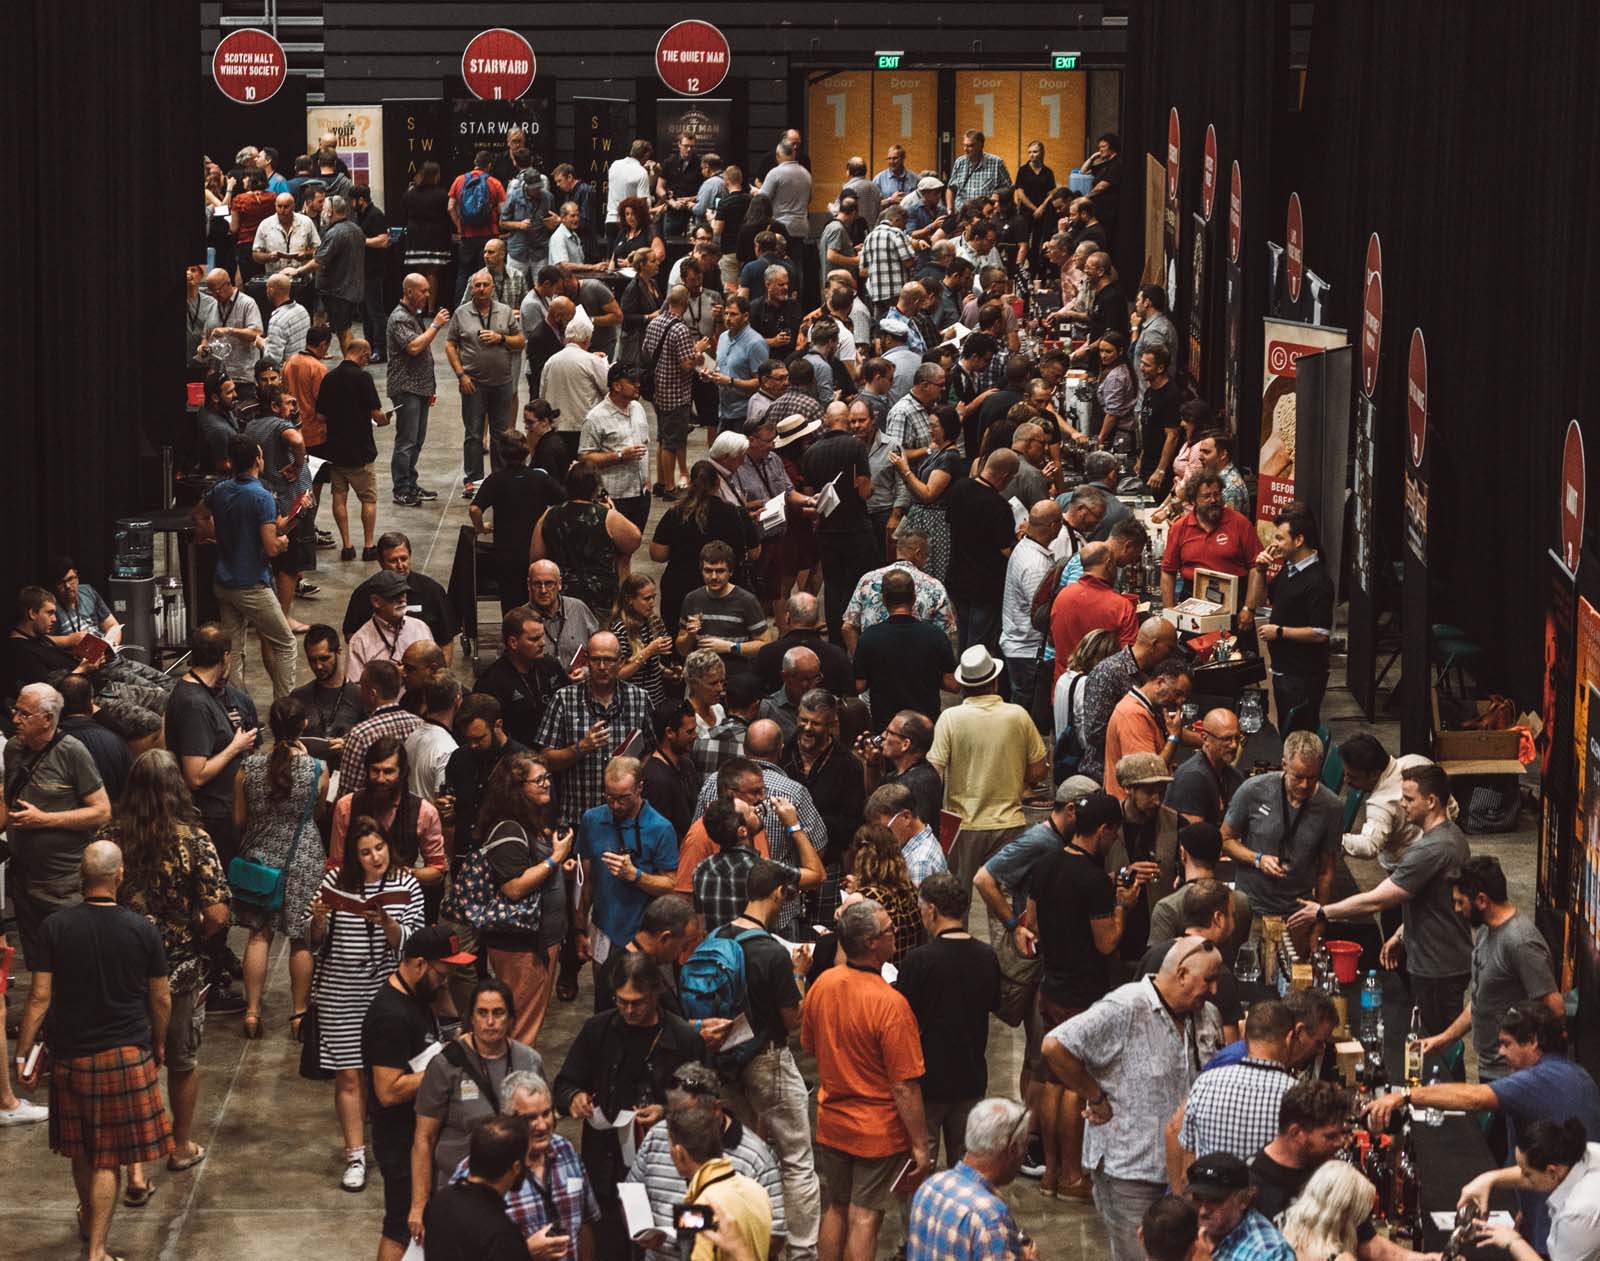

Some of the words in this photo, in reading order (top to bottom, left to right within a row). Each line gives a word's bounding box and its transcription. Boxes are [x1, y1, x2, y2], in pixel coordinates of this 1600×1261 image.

[224, 53, 253, 64] SCOTCH
[254, 53, 274, 64] MALT
[662, 50, 679, 62] THE
[680, 51, 705, 63] QUIET
[707, 51, 724, 63] MAN
[879, 56, 899, 68] EXIT
[470, 58, 528, 74] STARWARD
[1055, 57, 1076, 69] EXIT
[220, 65, 247, 76] WHISKY
[249, 65, 280, 76] SOCIETY
[687, 78, 699, 91] 12
[824, 78, 855, 88] Door
[890, 78, 921, 88] Door
[972, 78, 1003, 88] Door
[1039, 78, 1069, 88] Door
[245, 86, 256, 100] 10
[494, 86, 502, 100] 11
[826, 93, 847, 137] 1
[892, 93, 913, 137] 1
[974, 93, 995, 137] 1
[1040, 94, 1061, 138] 1
[332, 126, 355, 136] your
[1271, 481, 1295, 495] BEFOR
[1262, 504, 1276, 516] IT'S
